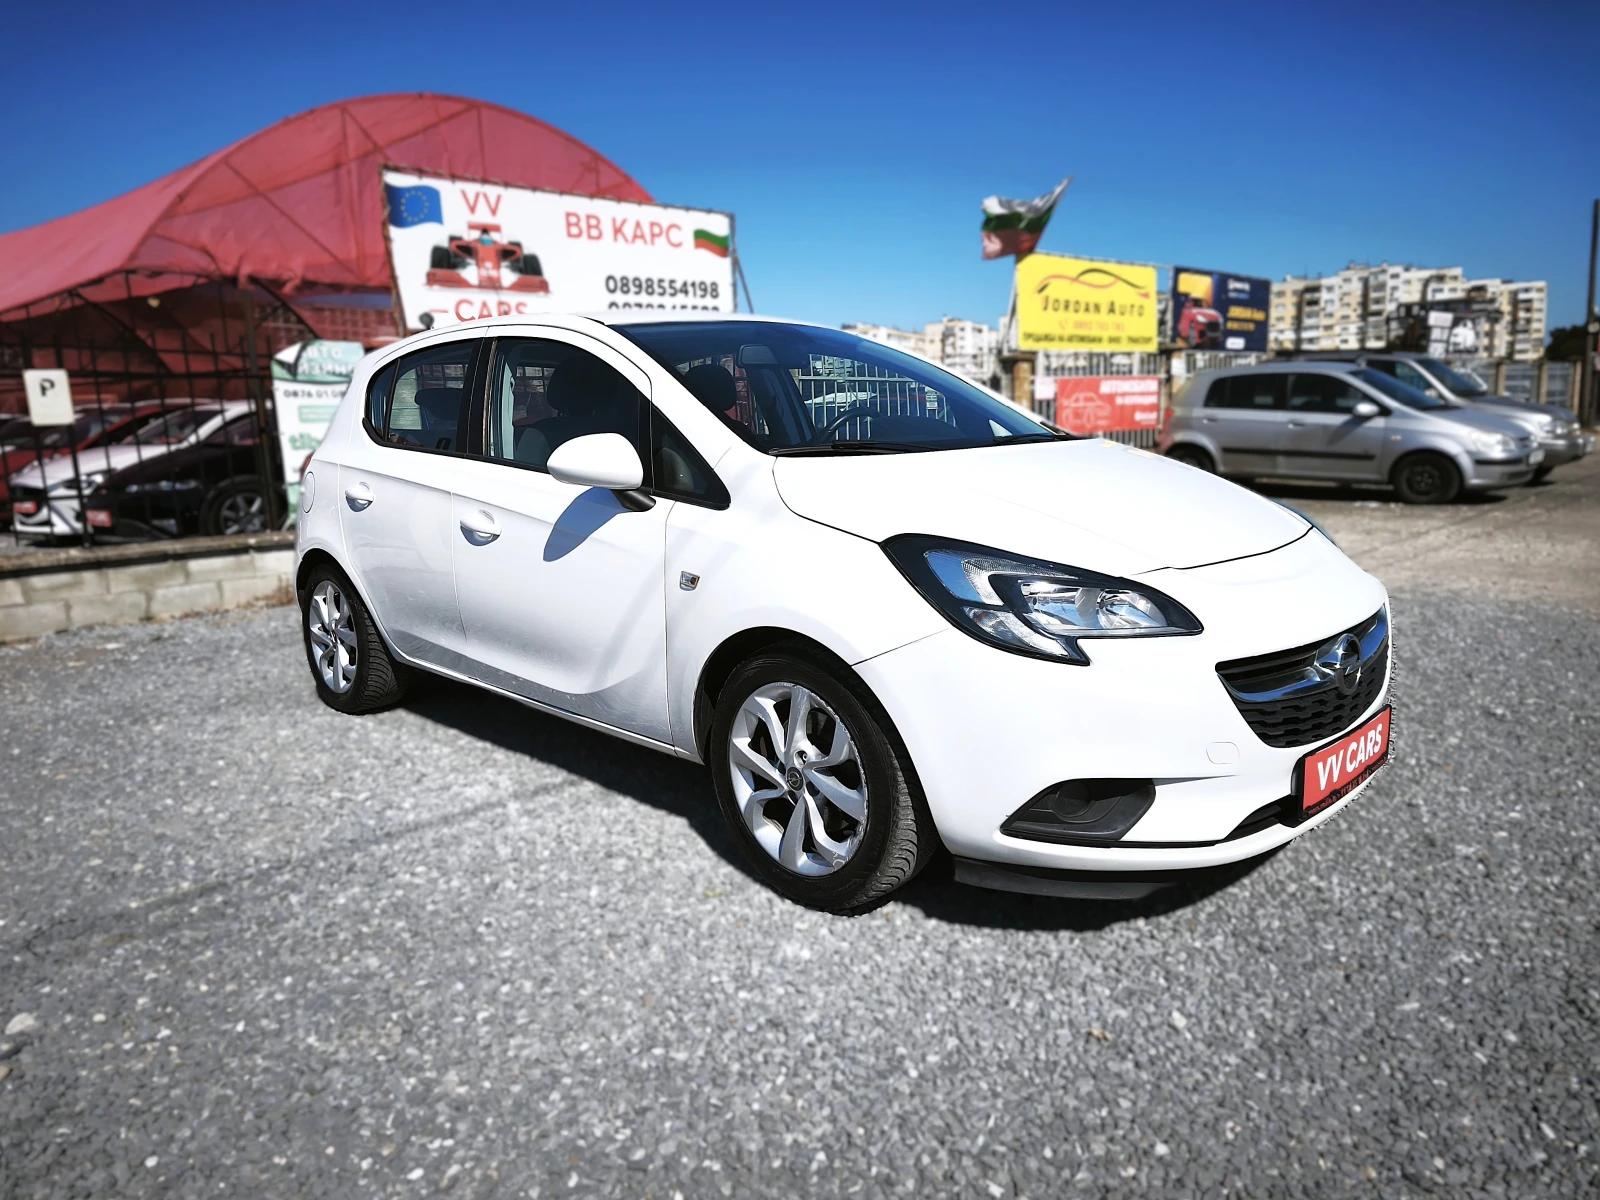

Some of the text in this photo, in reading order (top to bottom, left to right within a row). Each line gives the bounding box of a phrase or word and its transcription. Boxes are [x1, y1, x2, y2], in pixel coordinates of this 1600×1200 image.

[460, 189, 502, 217] VV
[612, 217, 684, 249] КАРС
[605, 274, 720, 299] 0898554198
[39, 378, 56, 397] P
[1316, 749, 1344, 791] VV
[1346, 723, 1383, 774] CARS
